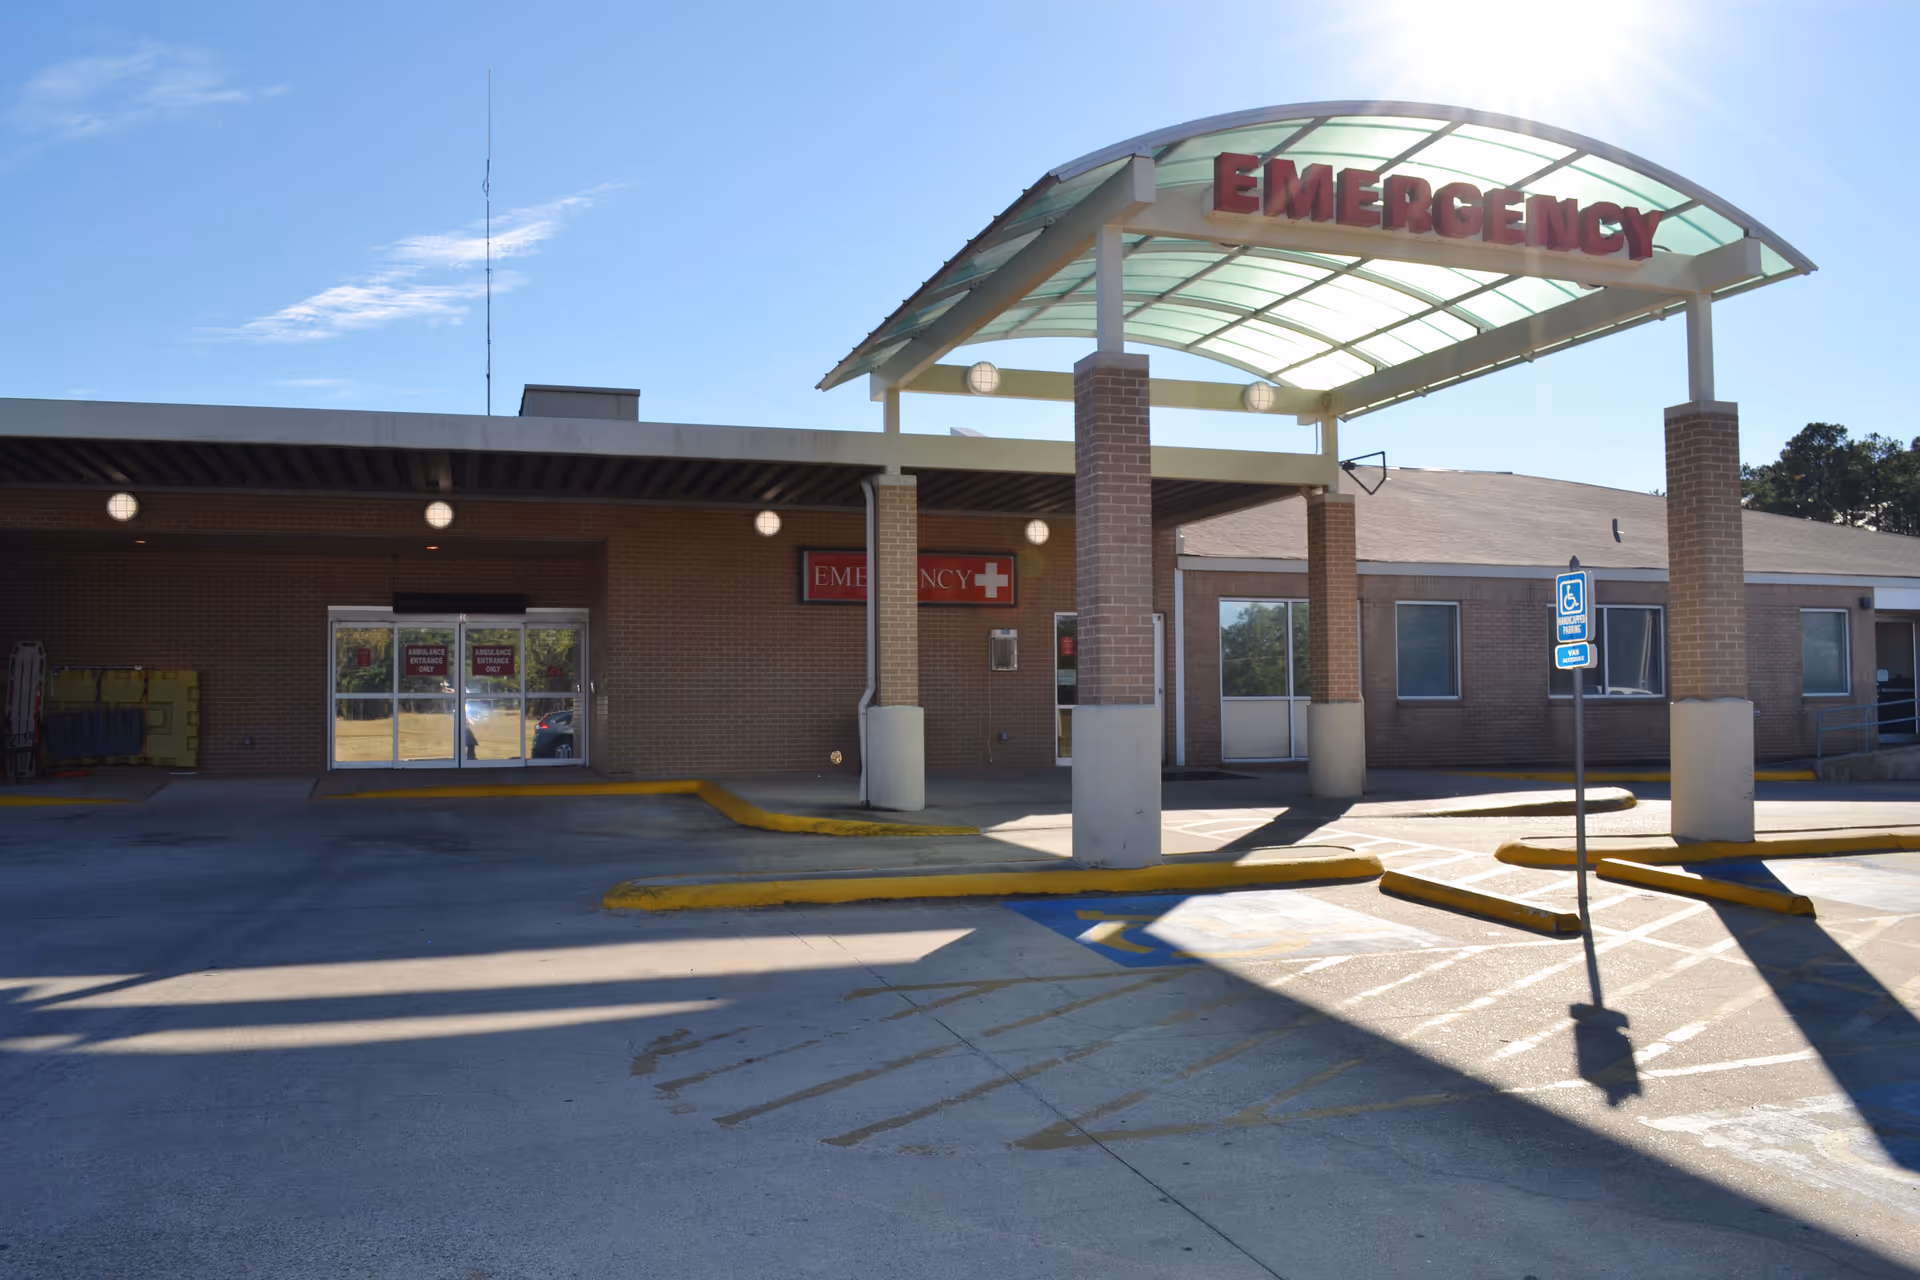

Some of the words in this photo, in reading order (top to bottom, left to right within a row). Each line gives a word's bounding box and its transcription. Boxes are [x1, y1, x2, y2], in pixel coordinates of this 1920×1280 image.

[1213, 152, 1665, 261] EMERGENCY
[814, 566, 972, 589] EMENCY
[408, 648, 445, 656] AMBULANCE
[475, 648, 512, 656] AMBULANCE
[418, 665, 435, 673] ONLY
[485, 665, 501, 673] ONLY
